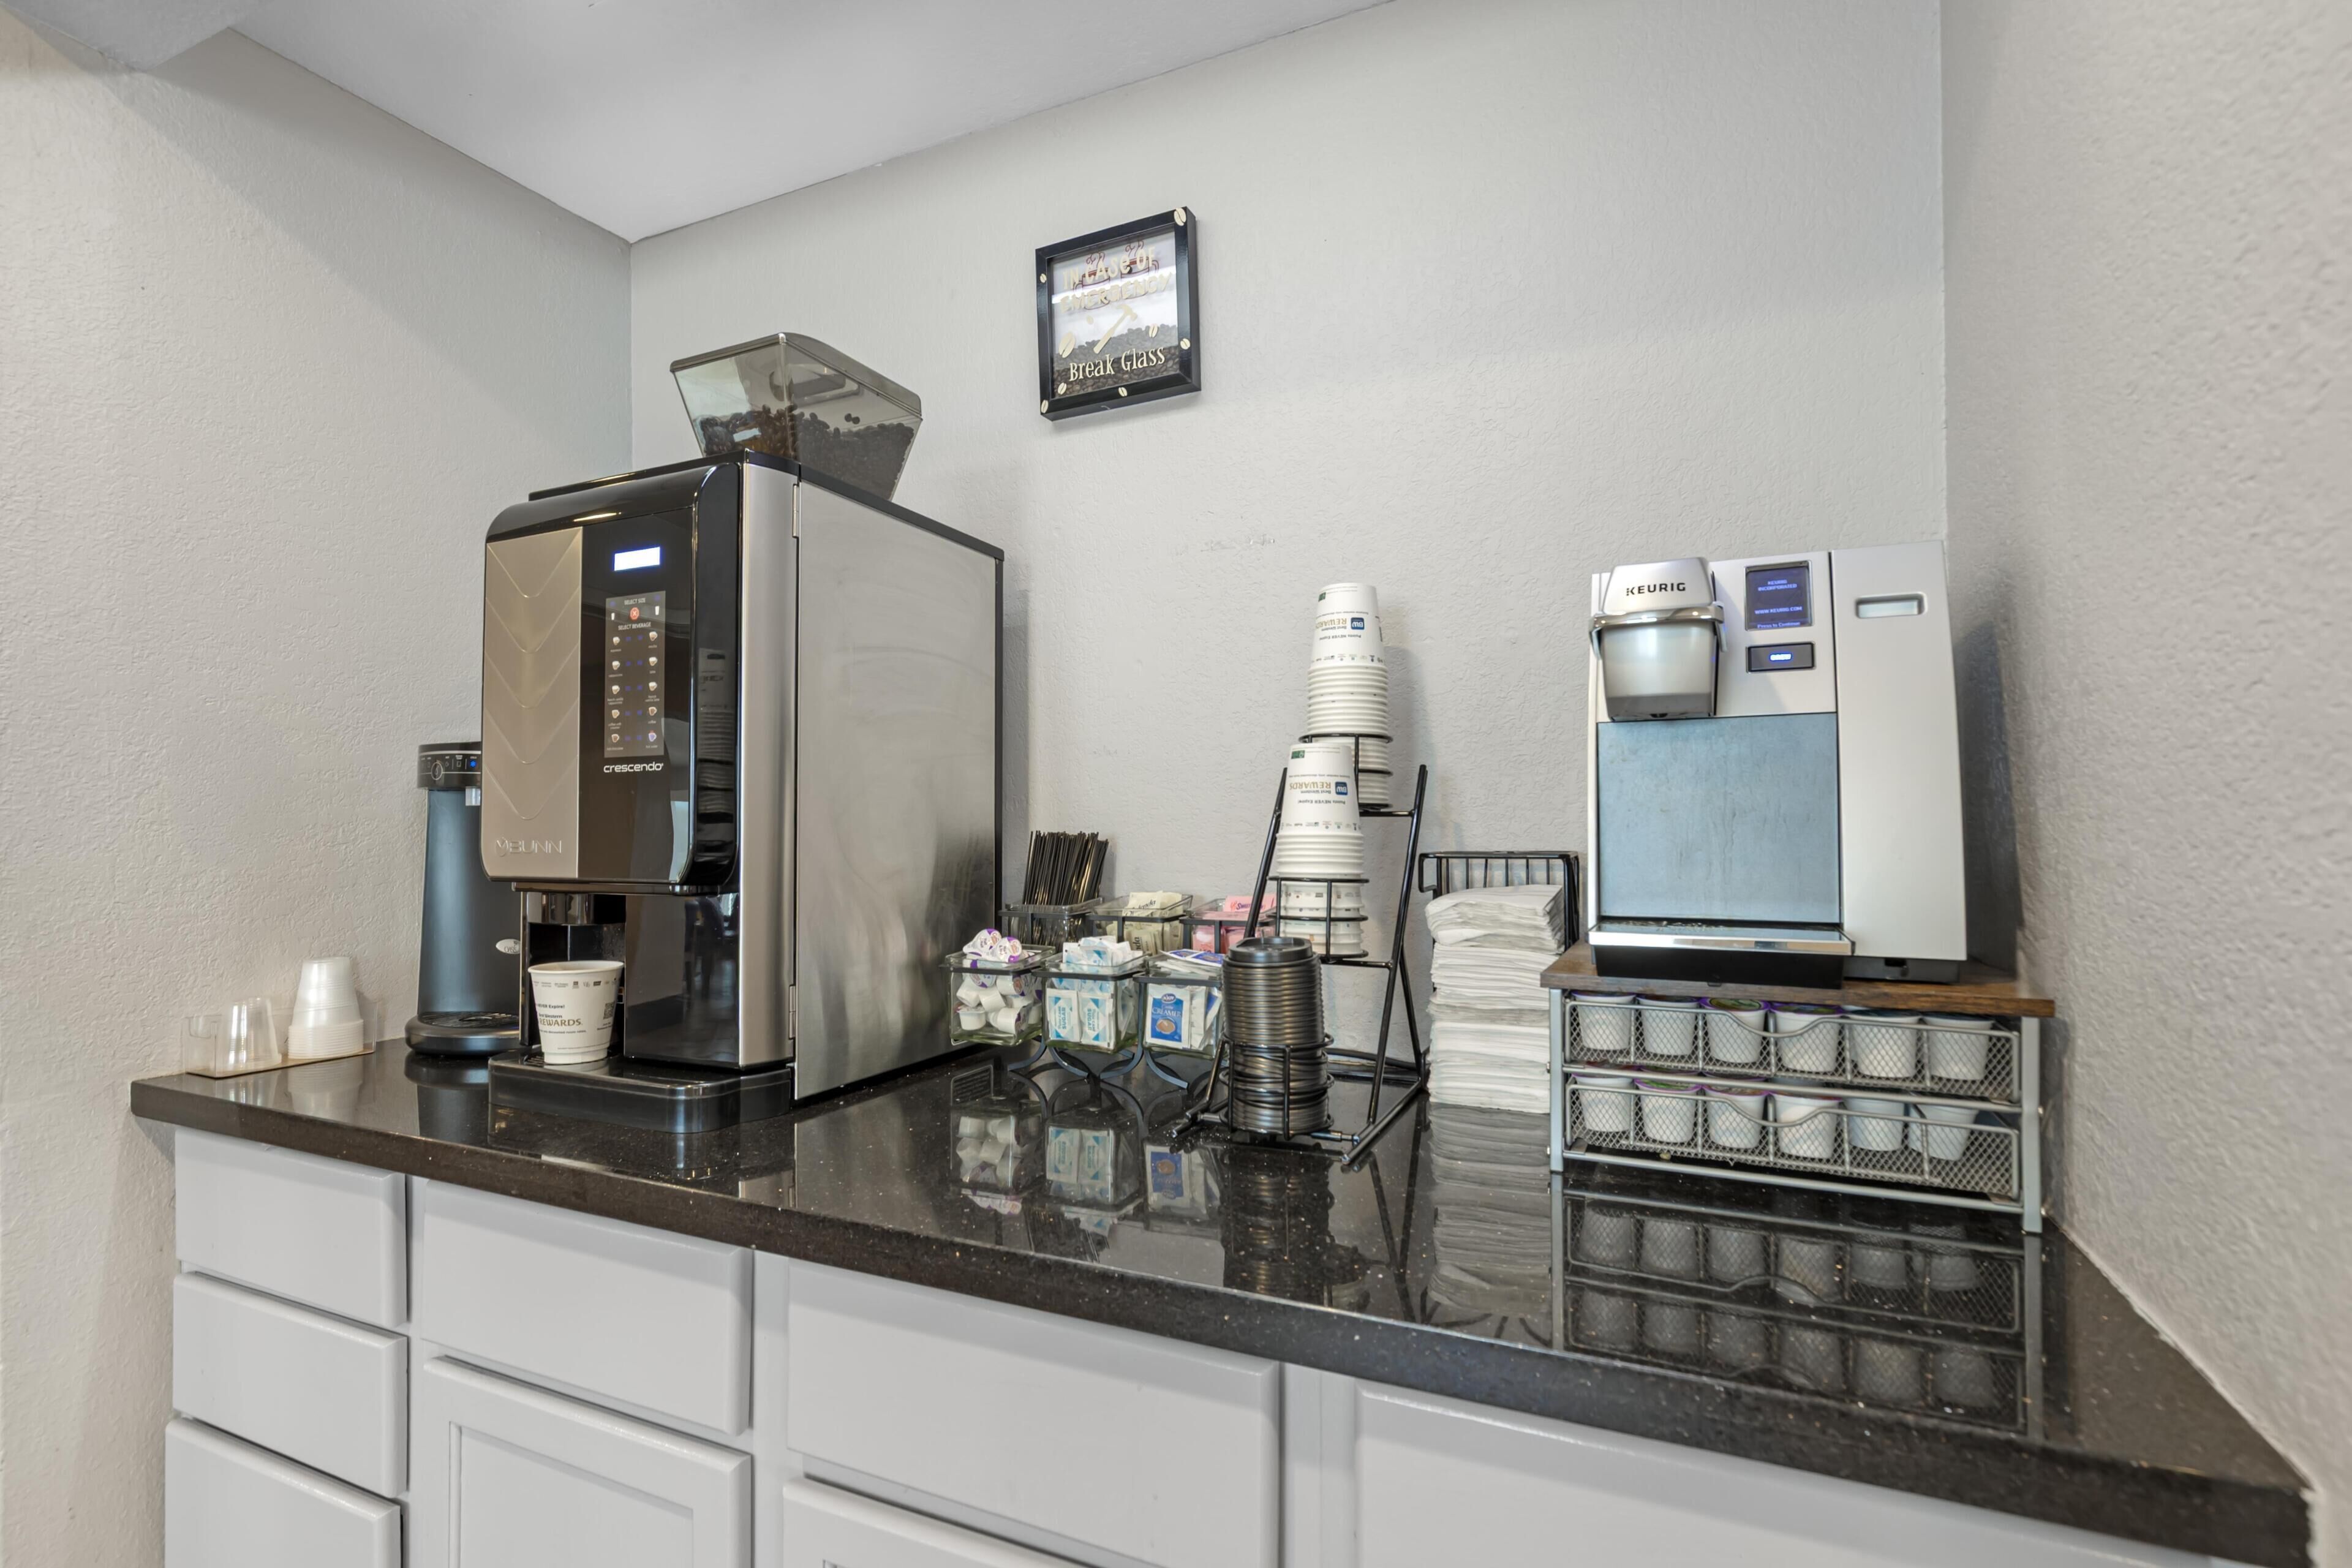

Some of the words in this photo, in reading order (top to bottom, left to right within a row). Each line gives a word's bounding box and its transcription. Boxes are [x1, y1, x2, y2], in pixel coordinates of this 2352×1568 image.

[1136, 246, 1156, 270] OF
[1060, 272, 1172, 314] EMERGENCY
[1069, 354, 1115, 382] Break
[1121, 347, 1166, 372] Glass
[1626, 582, 1686, 596] KEURIG
[603, 762, 662, 772] crescendo
[510, 840, 562, 853] BUNN
[1152, 1007, 1182, 1017] CREAMER
[539, 1018, 581, 1027] REWARDS
